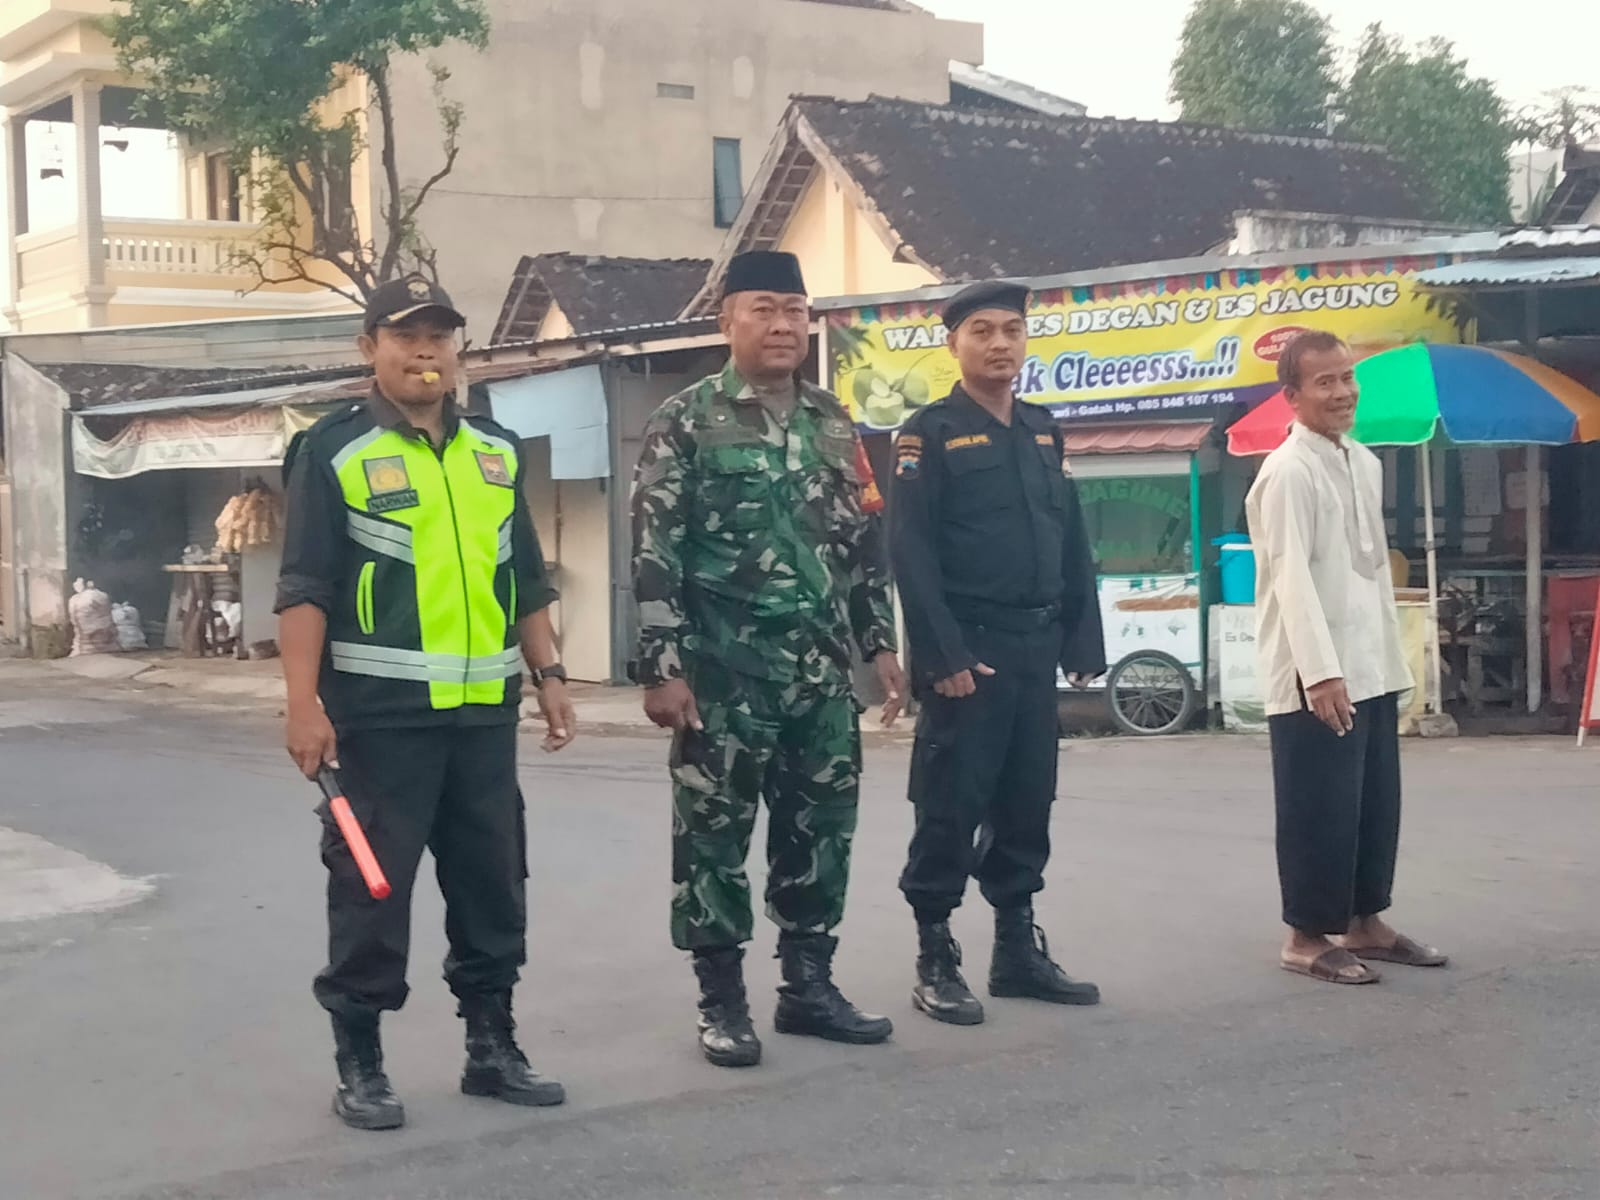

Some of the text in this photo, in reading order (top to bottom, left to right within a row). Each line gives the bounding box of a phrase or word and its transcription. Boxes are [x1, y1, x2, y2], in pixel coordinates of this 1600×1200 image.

[883, 324, 948, 352] WAR
[1067, 301, 1179, 334] DEGAN
[1183, 298, 1211, 321] &
[1215, 294, 1257, 320] ES
[1260, 282, 1400, 314] JAGUNG
